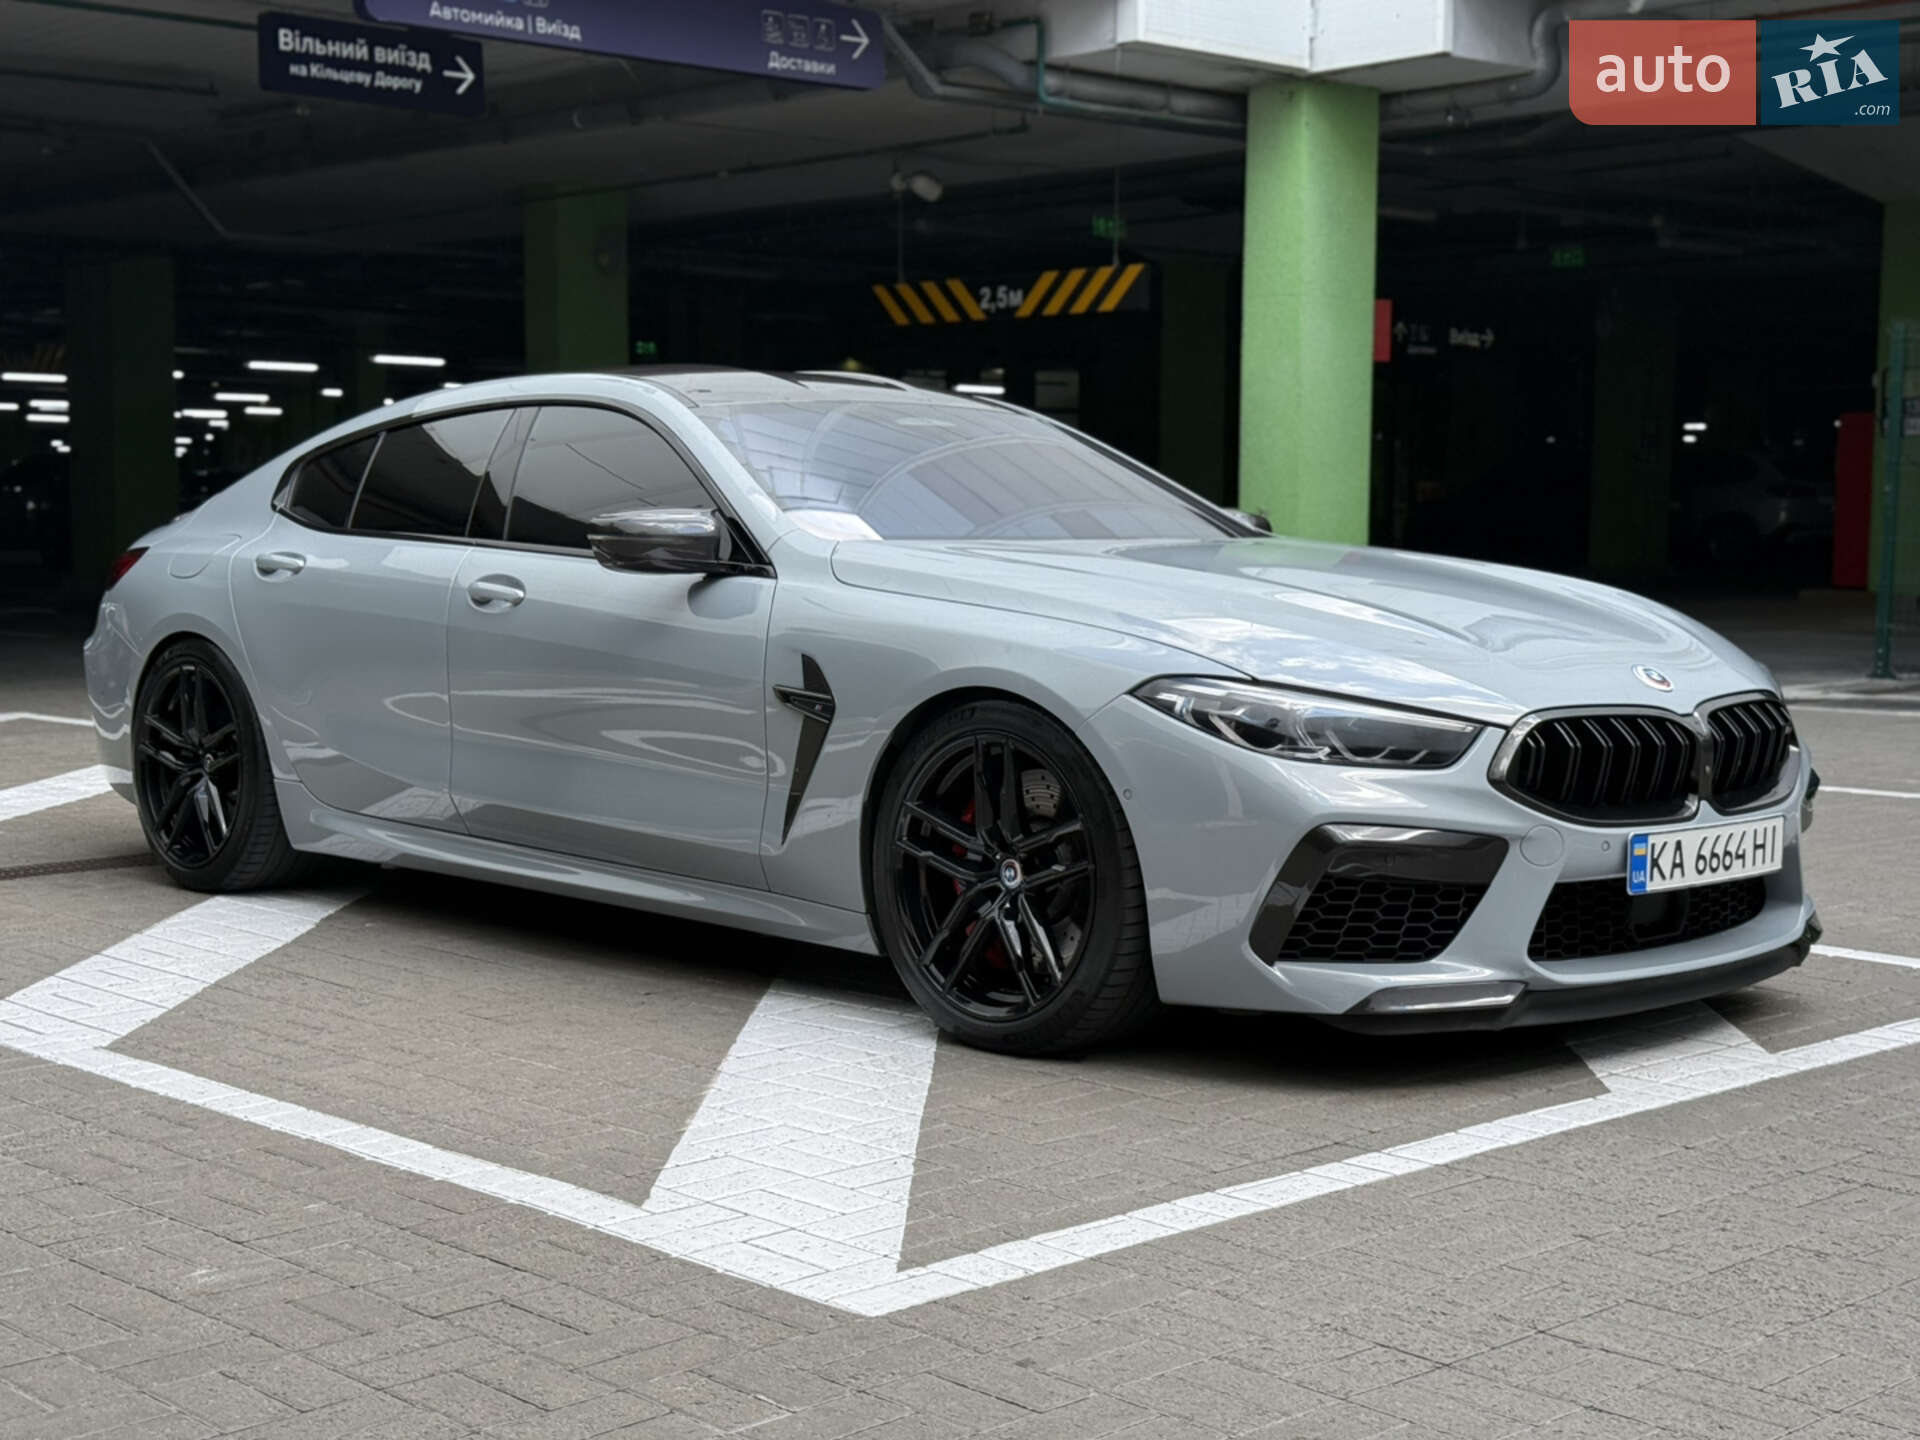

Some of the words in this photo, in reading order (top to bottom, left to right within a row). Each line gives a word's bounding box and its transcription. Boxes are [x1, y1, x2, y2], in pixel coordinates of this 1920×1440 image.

[429, 1, 524, 32] Автомийка
[535, 16, 583, 42] Виїзд
[277, 27, 370, 62] Вільний
[373, 43, 433, 75] виїзд
[767, 50, 838, 76] Доставки
[288, 63, 309, 78] на
[309, 62, 373, 88] Кільцеву
[373, 71, 424, 95] Дорогу
[1649, 838, 1686, 883] KA
[1694, 829, 1747, 876] 6664
[1751, 824, 1777, 868] HI
[1631, 869, 1647, 884] UA
